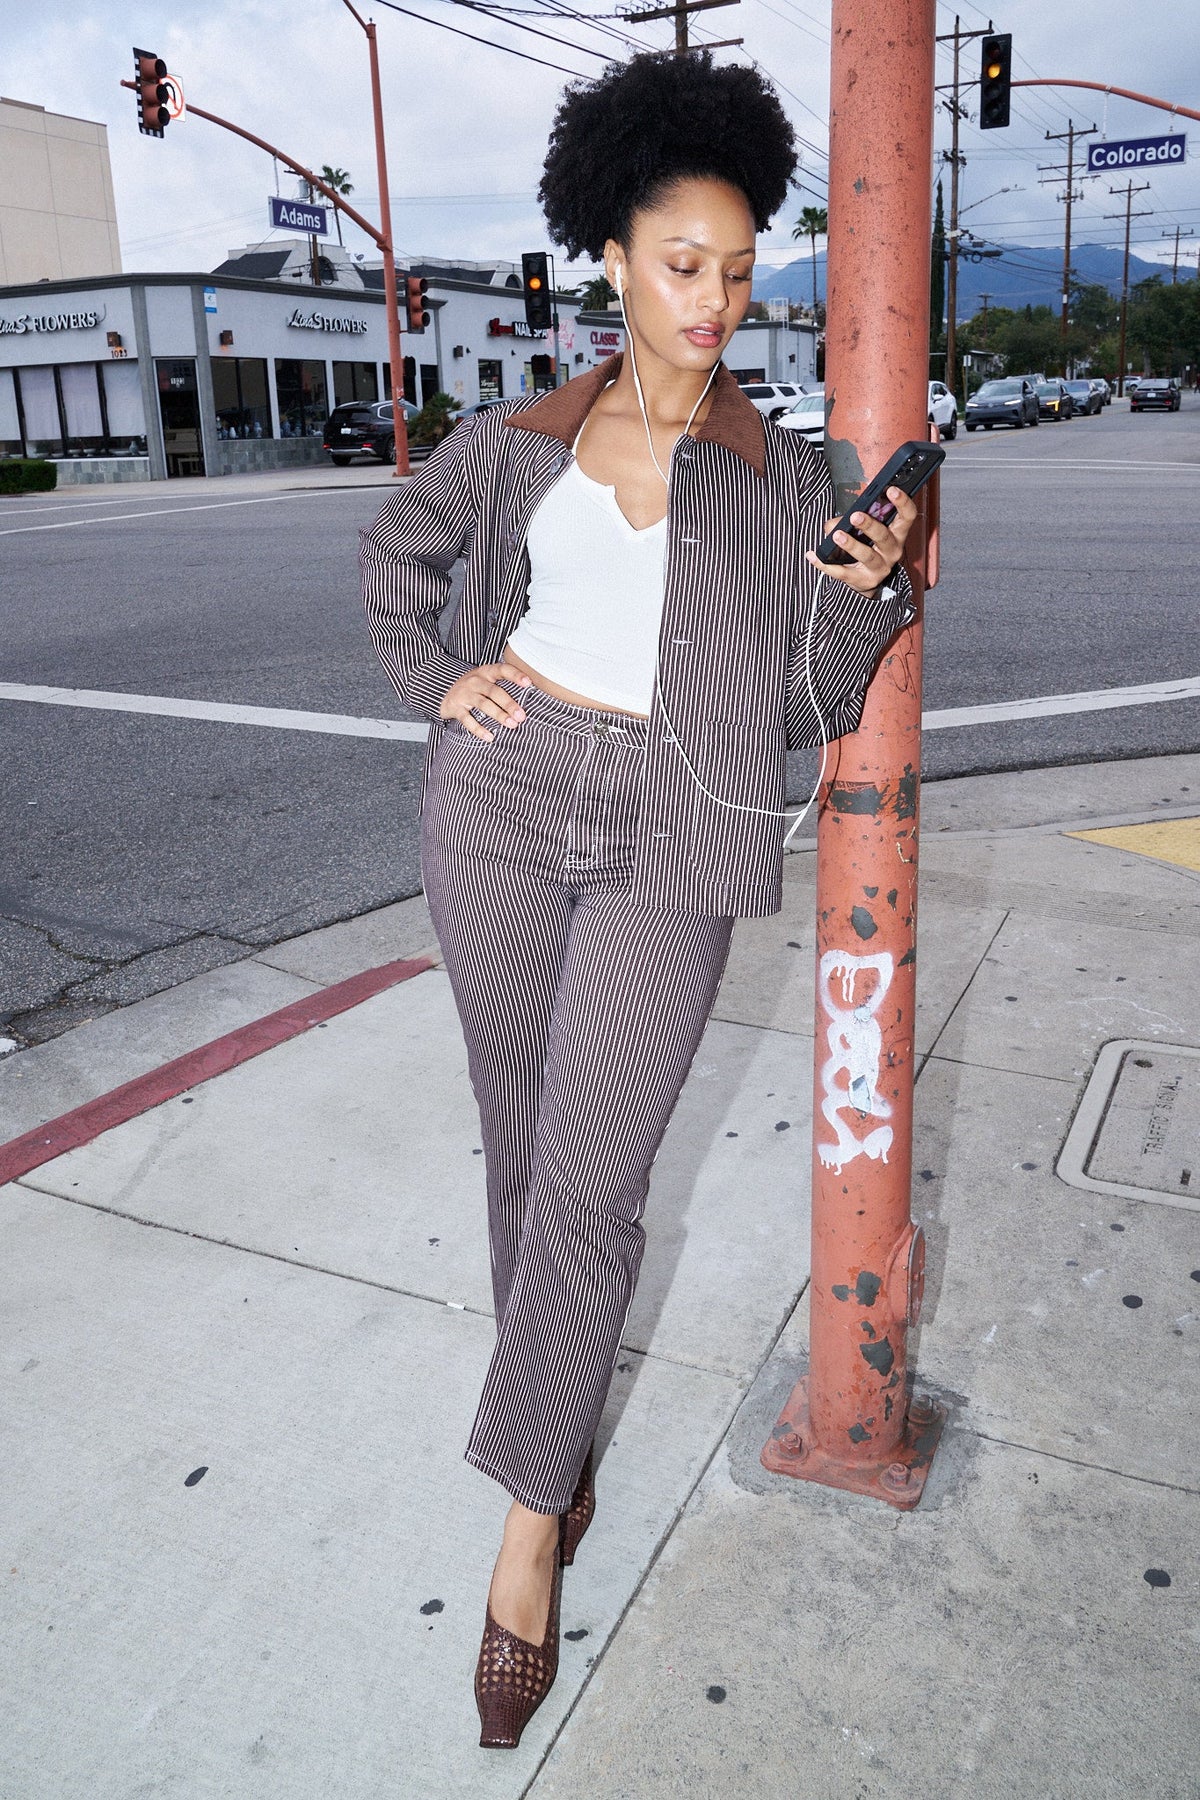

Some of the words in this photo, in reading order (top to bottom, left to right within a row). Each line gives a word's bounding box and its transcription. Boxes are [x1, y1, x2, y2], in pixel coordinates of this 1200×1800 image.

[1091, 141, 1182, 166] Colorado
[279, 204, 321, 229] Adams
[33, 312, 97, 332] FLOWERS
[323, 316, 369, 334] FLOWERS
[590, 331, 620, 346] CLASSIC
[1155, 1079, 1179, 1110] SIGNAL
[1143, 1115, 1170, 1155] TRAFFIC
